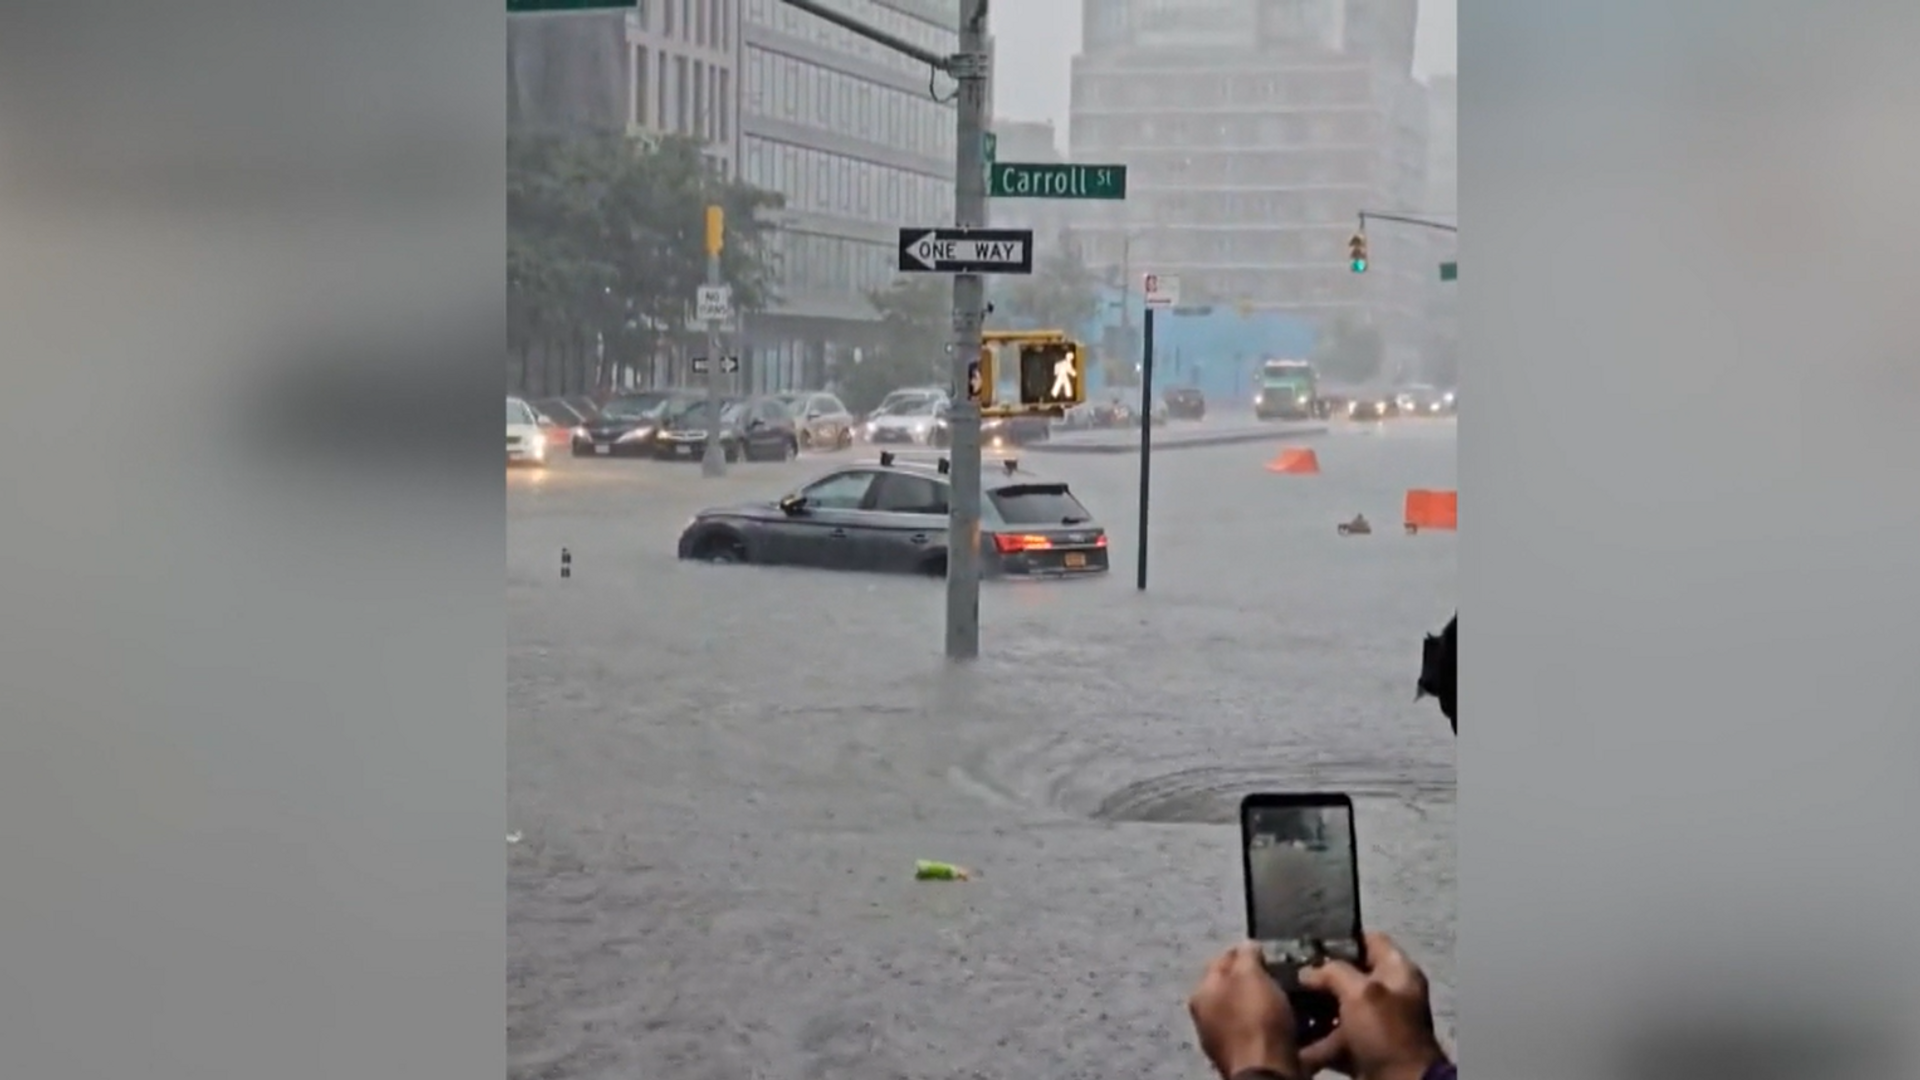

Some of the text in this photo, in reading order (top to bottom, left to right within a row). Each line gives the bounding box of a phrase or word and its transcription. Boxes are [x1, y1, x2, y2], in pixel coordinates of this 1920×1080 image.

[1003, 167, 1112, 195] Carroll St
[919, 242, 1015, 261] ONE WAY
[705, 291, 720, 303] NO
